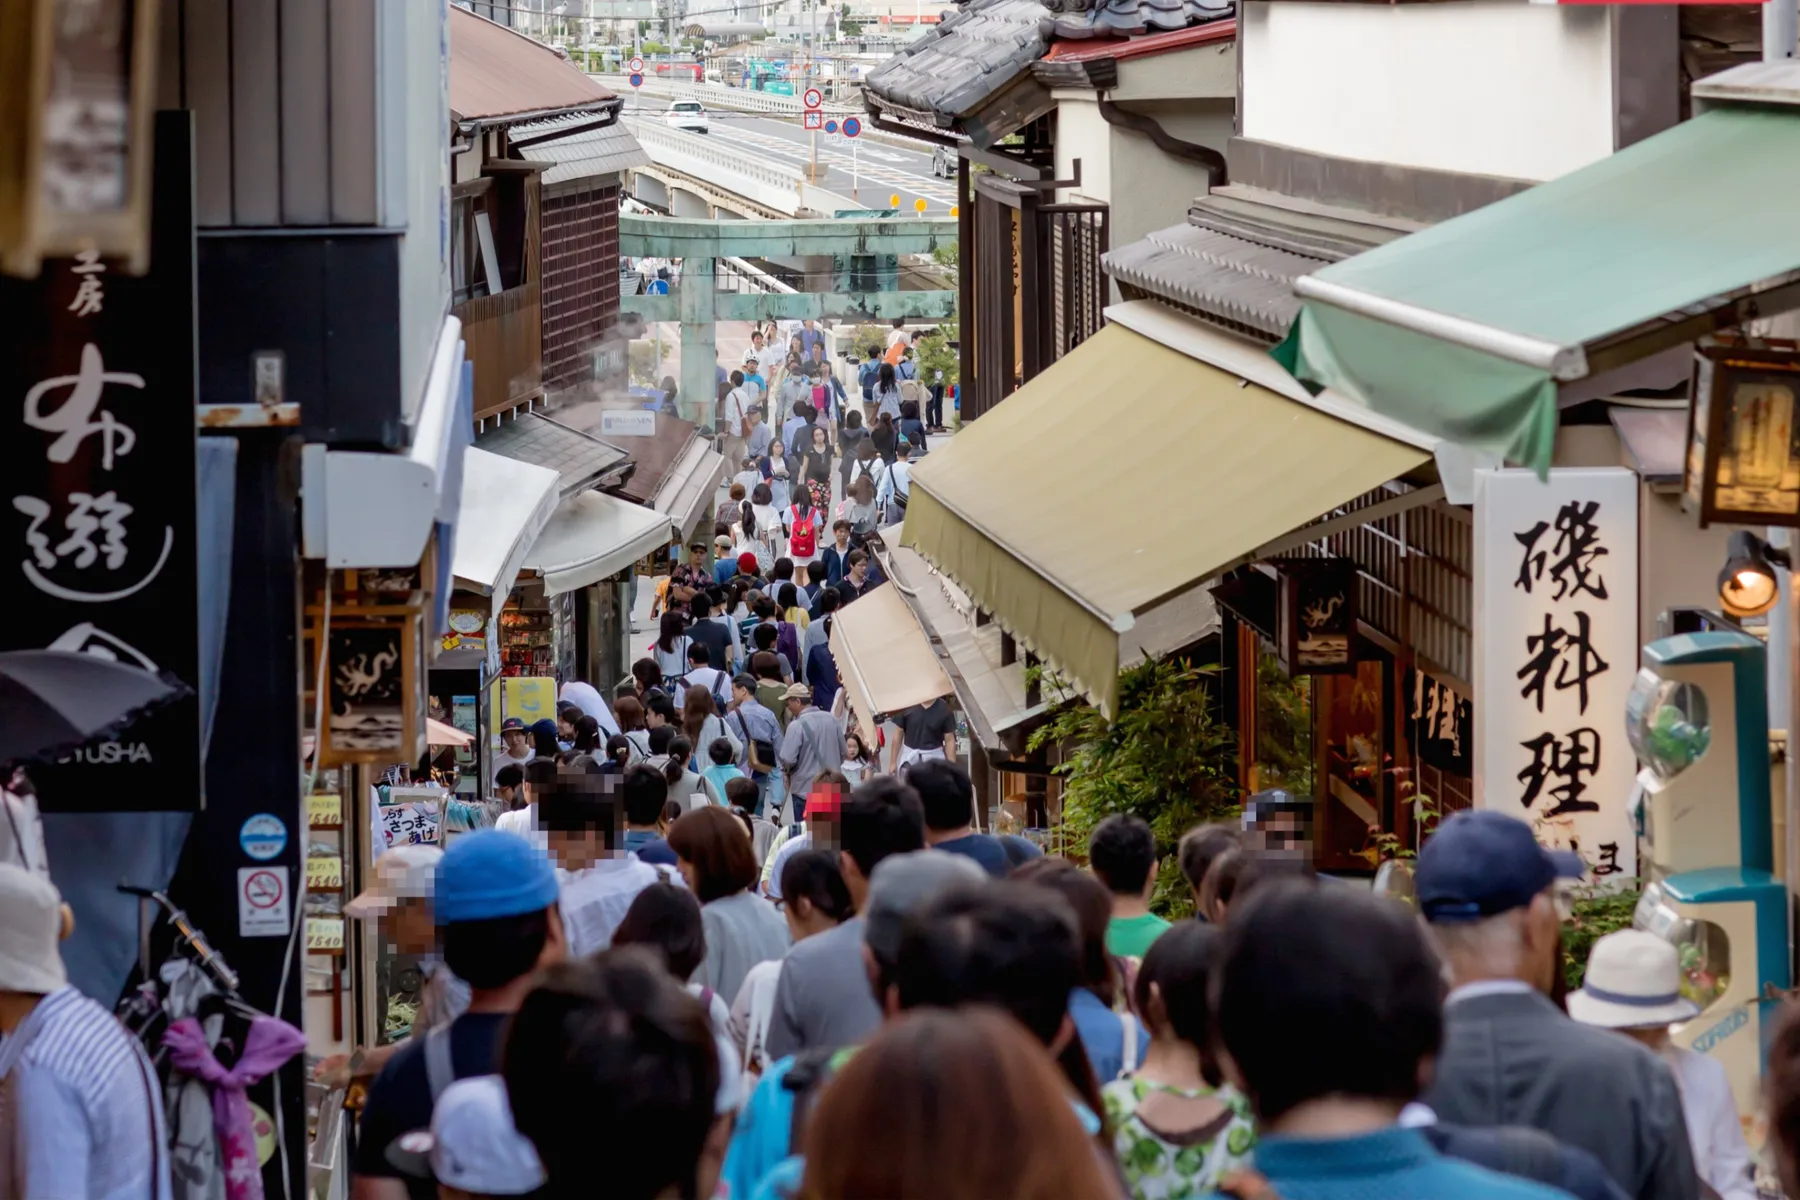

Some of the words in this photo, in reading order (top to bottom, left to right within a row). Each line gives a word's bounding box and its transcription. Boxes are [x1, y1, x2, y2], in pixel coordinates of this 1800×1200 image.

[1513, 500, 1611, 820] 磯料理
[58, 741, 153, 764] YUSHA
[389, 814, 427, 833] さつま
[408, 826, 436, 843] あげ
